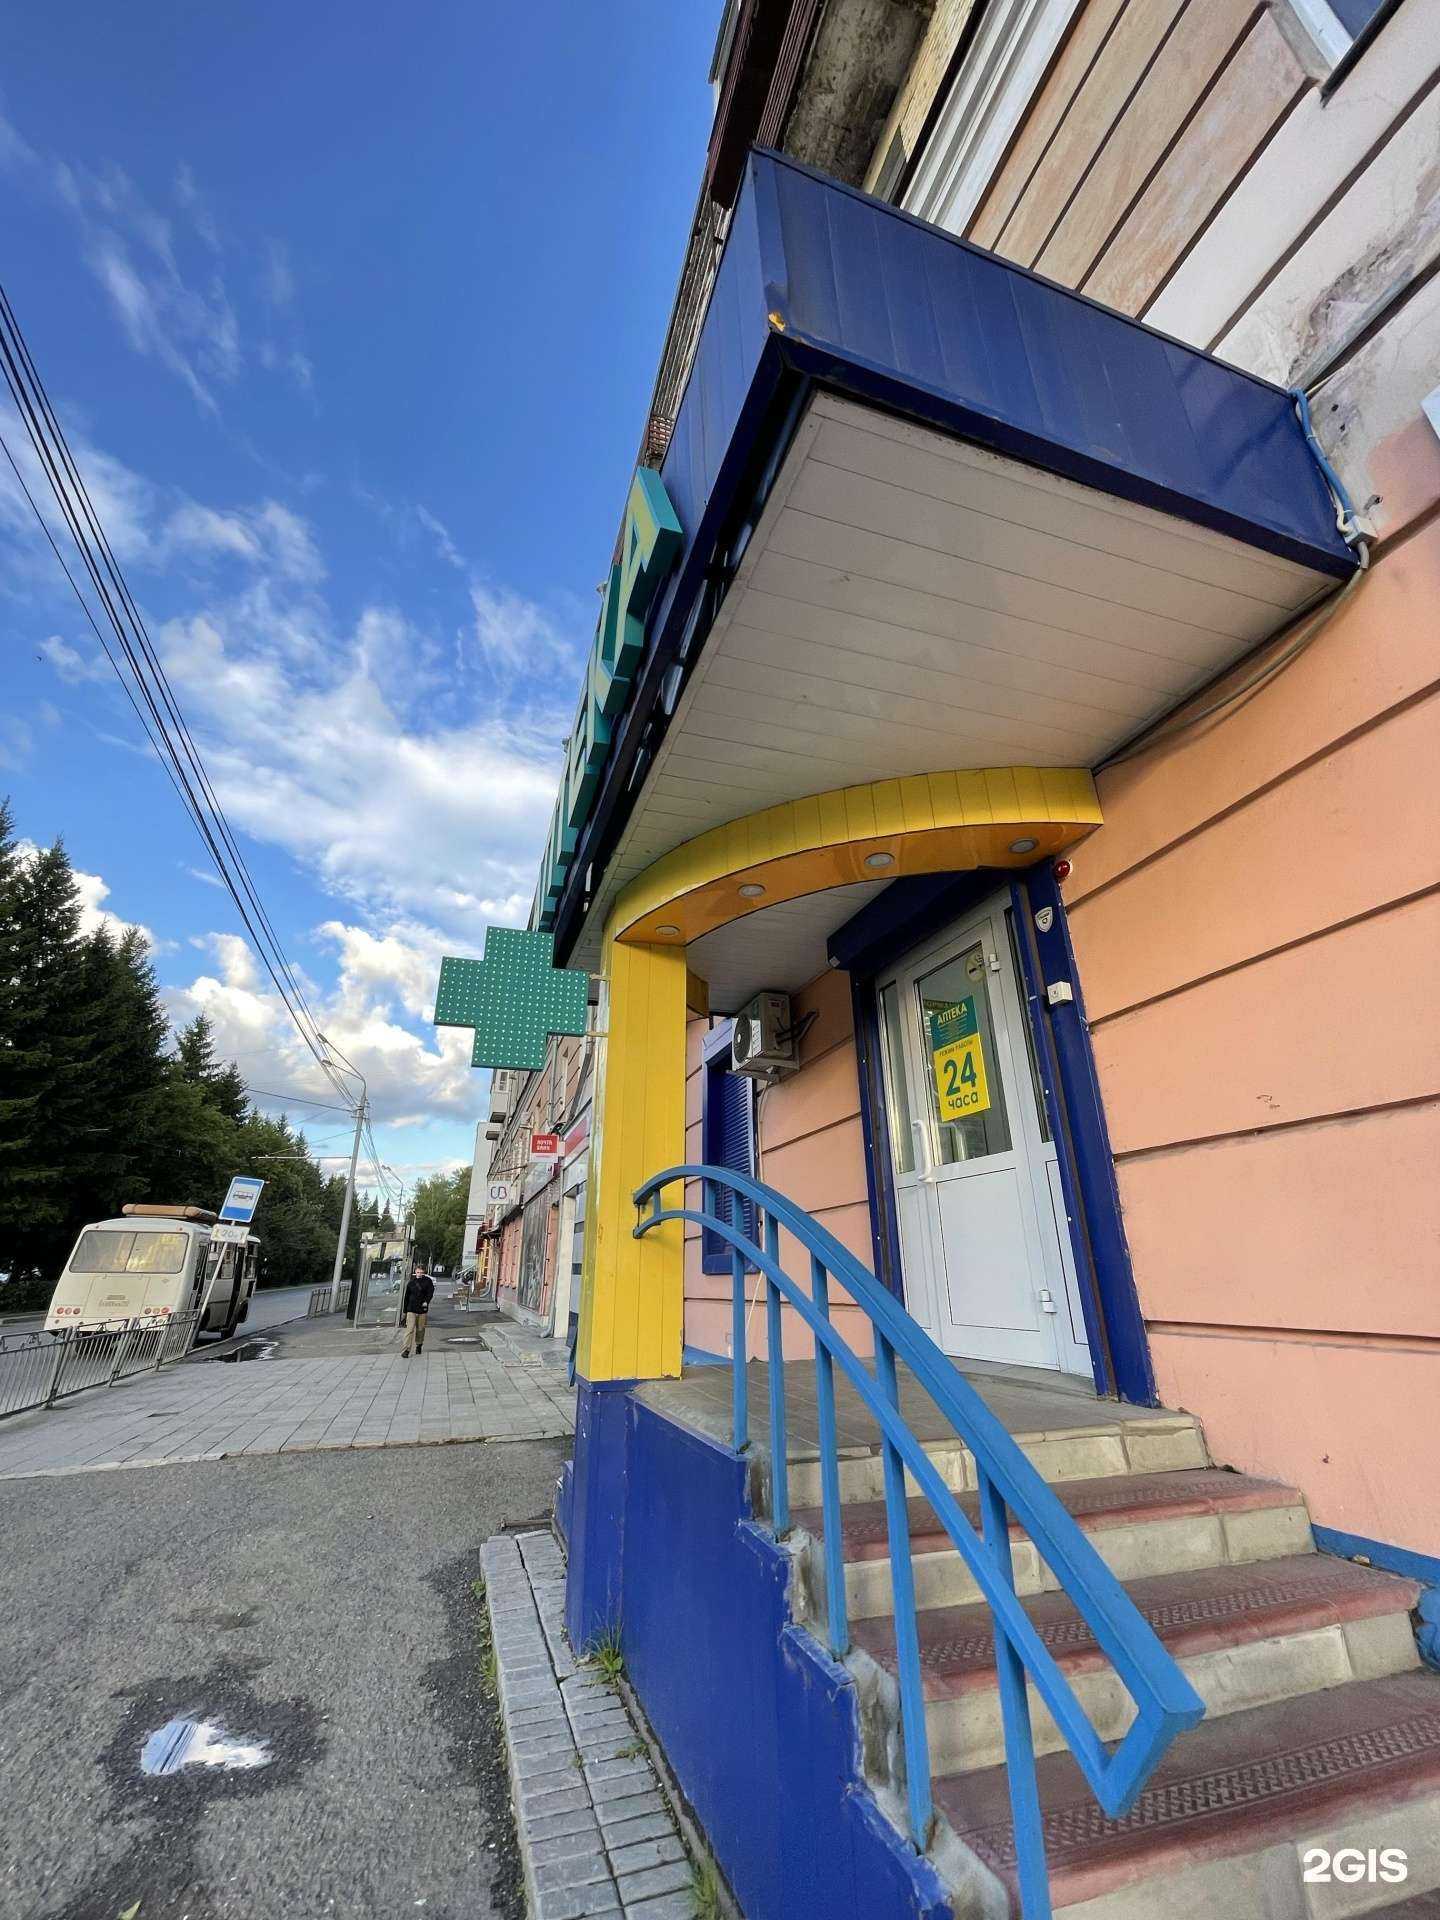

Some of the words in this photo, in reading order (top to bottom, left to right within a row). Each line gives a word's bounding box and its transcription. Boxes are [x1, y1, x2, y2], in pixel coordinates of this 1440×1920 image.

[937, 1003, 968, 1025] АПТЕКА
[943, 1051, 977, 1096] 24
[948, 1092, 979, 1110] часа
